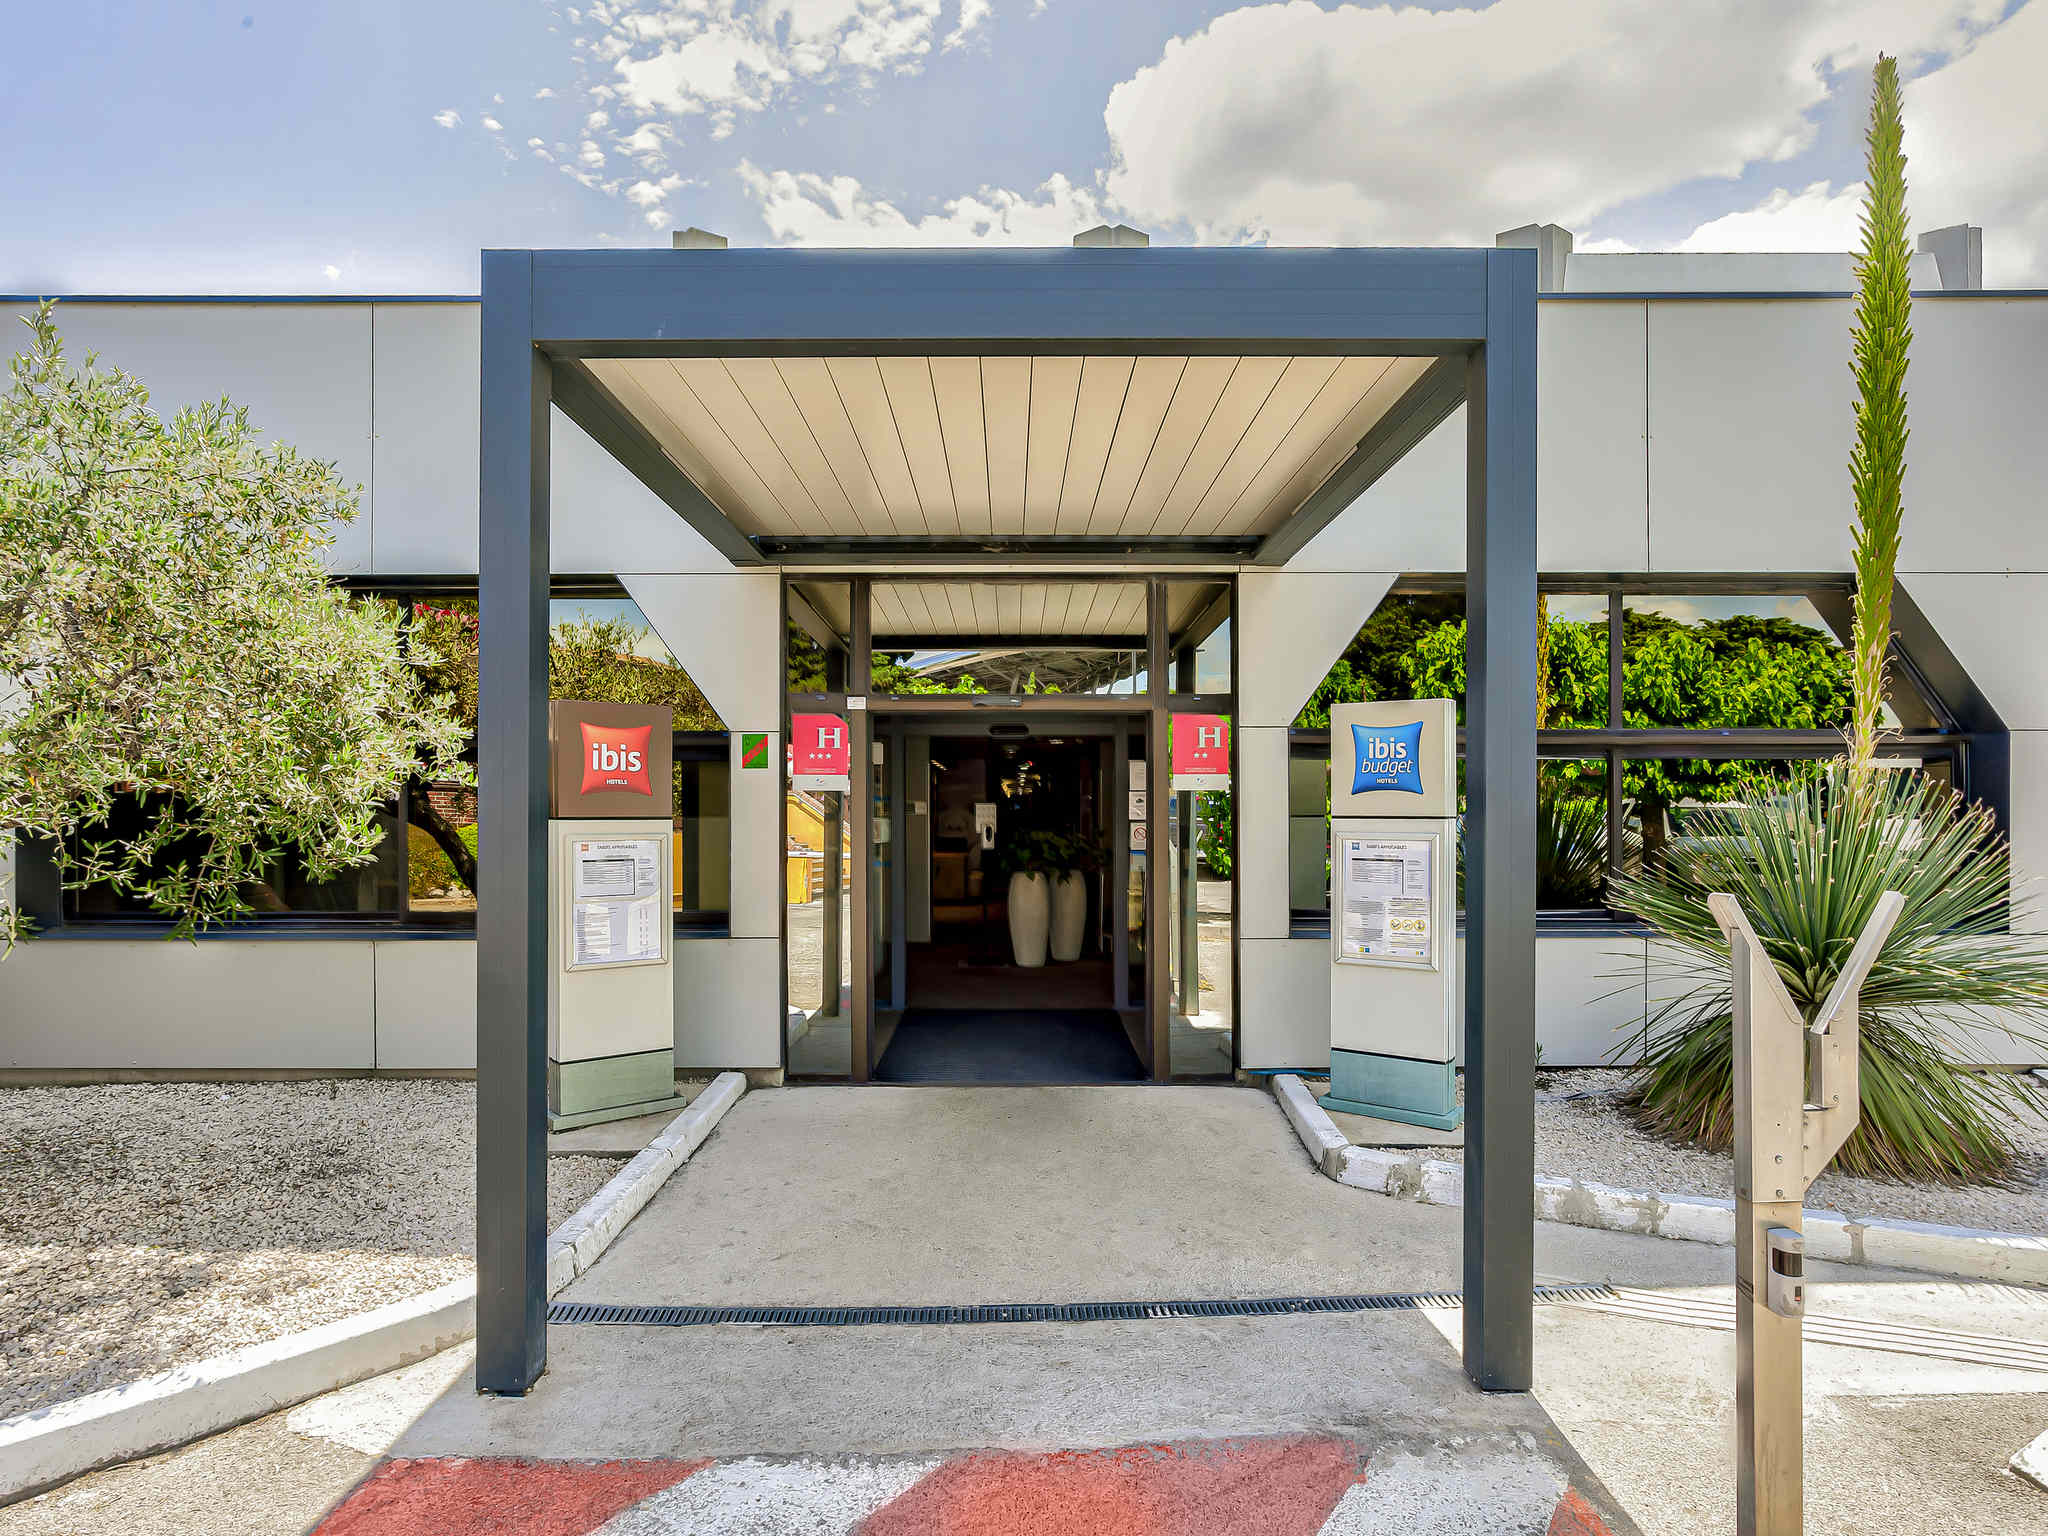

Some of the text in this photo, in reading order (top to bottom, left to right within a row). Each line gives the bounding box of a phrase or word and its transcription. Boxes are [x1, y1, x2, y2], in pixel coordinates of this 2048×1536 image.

[816, 727, 842, 749] H
[1196, 726, 1224, 748] H
[1368, 737, 1407, 759] ibis
[592, 743, 642, 772] ibis
[1361, 757, 1413, 777] budget
